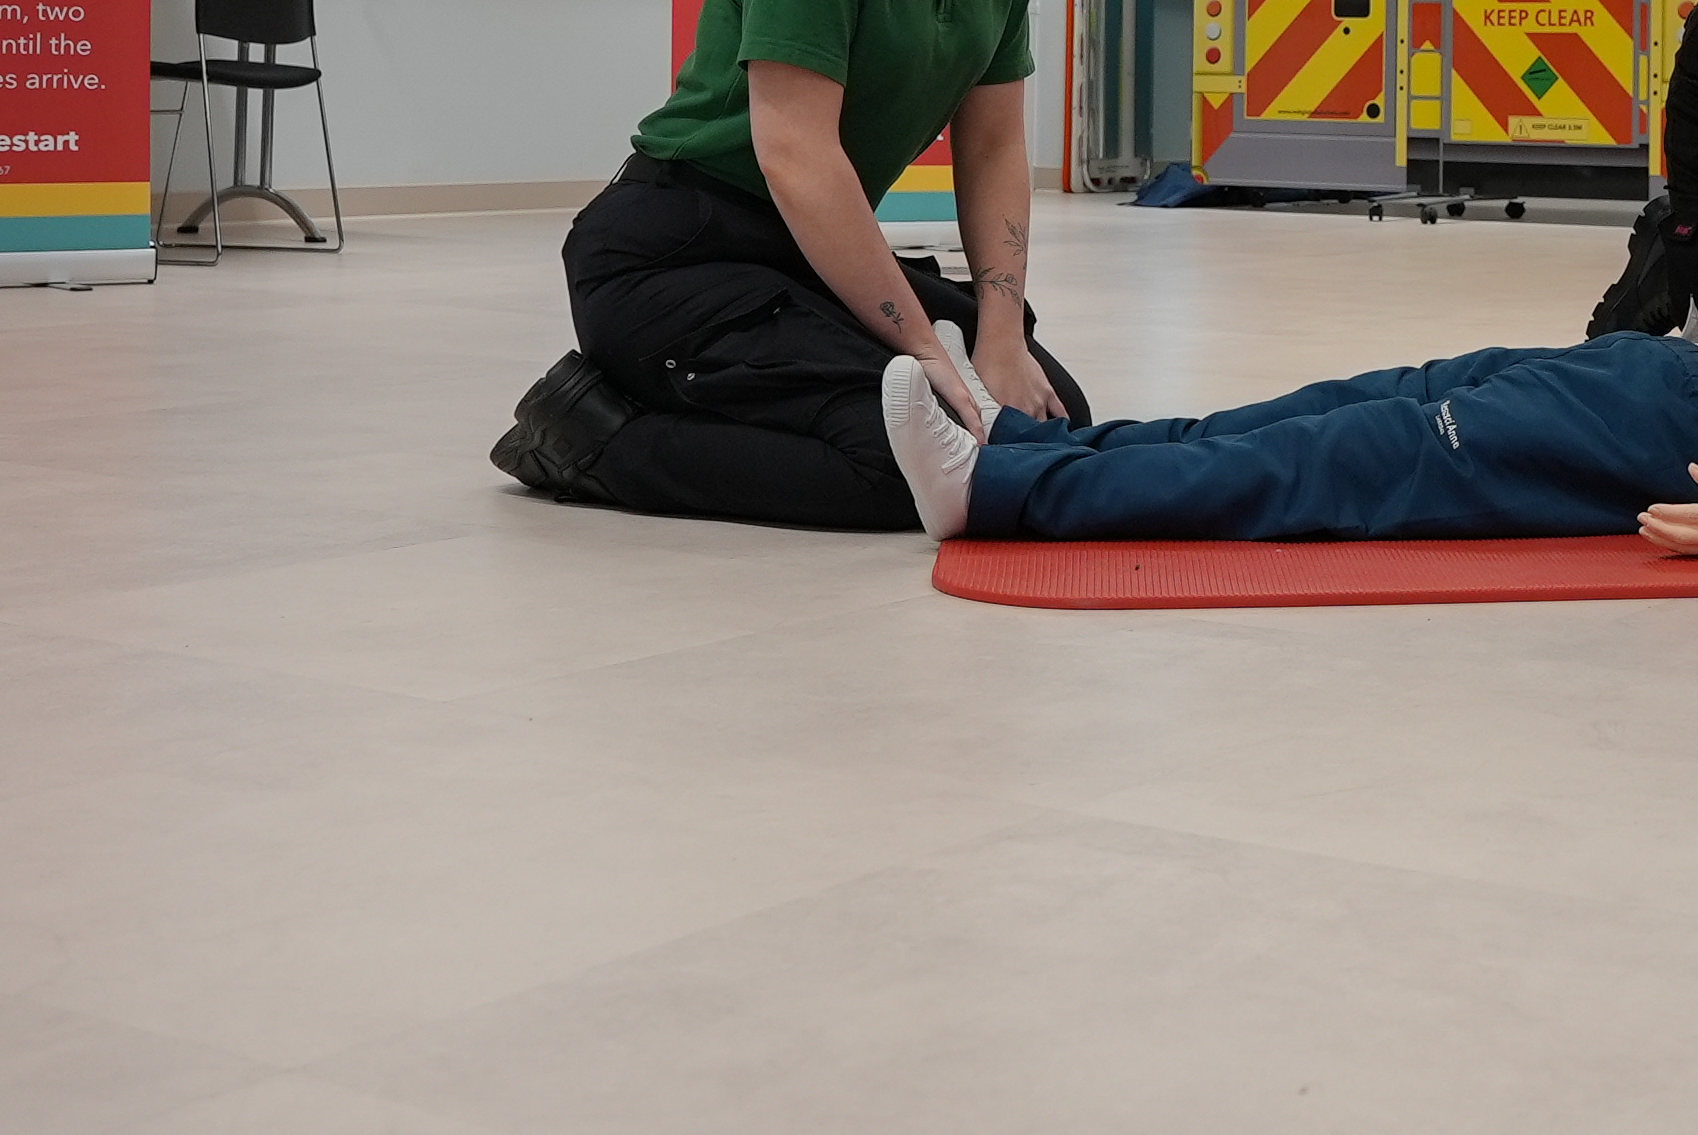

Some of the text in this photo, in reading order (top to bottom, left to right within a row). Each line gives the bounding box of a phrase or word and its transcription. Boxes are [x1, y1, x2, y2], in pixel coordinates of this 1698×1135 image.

[36, 2, 85, 22] two
[1484, 9, 1595, 27] KEEP CLEAR
[49, 32, 92, 56] the
[25, 69, 106, 90] arrive.
